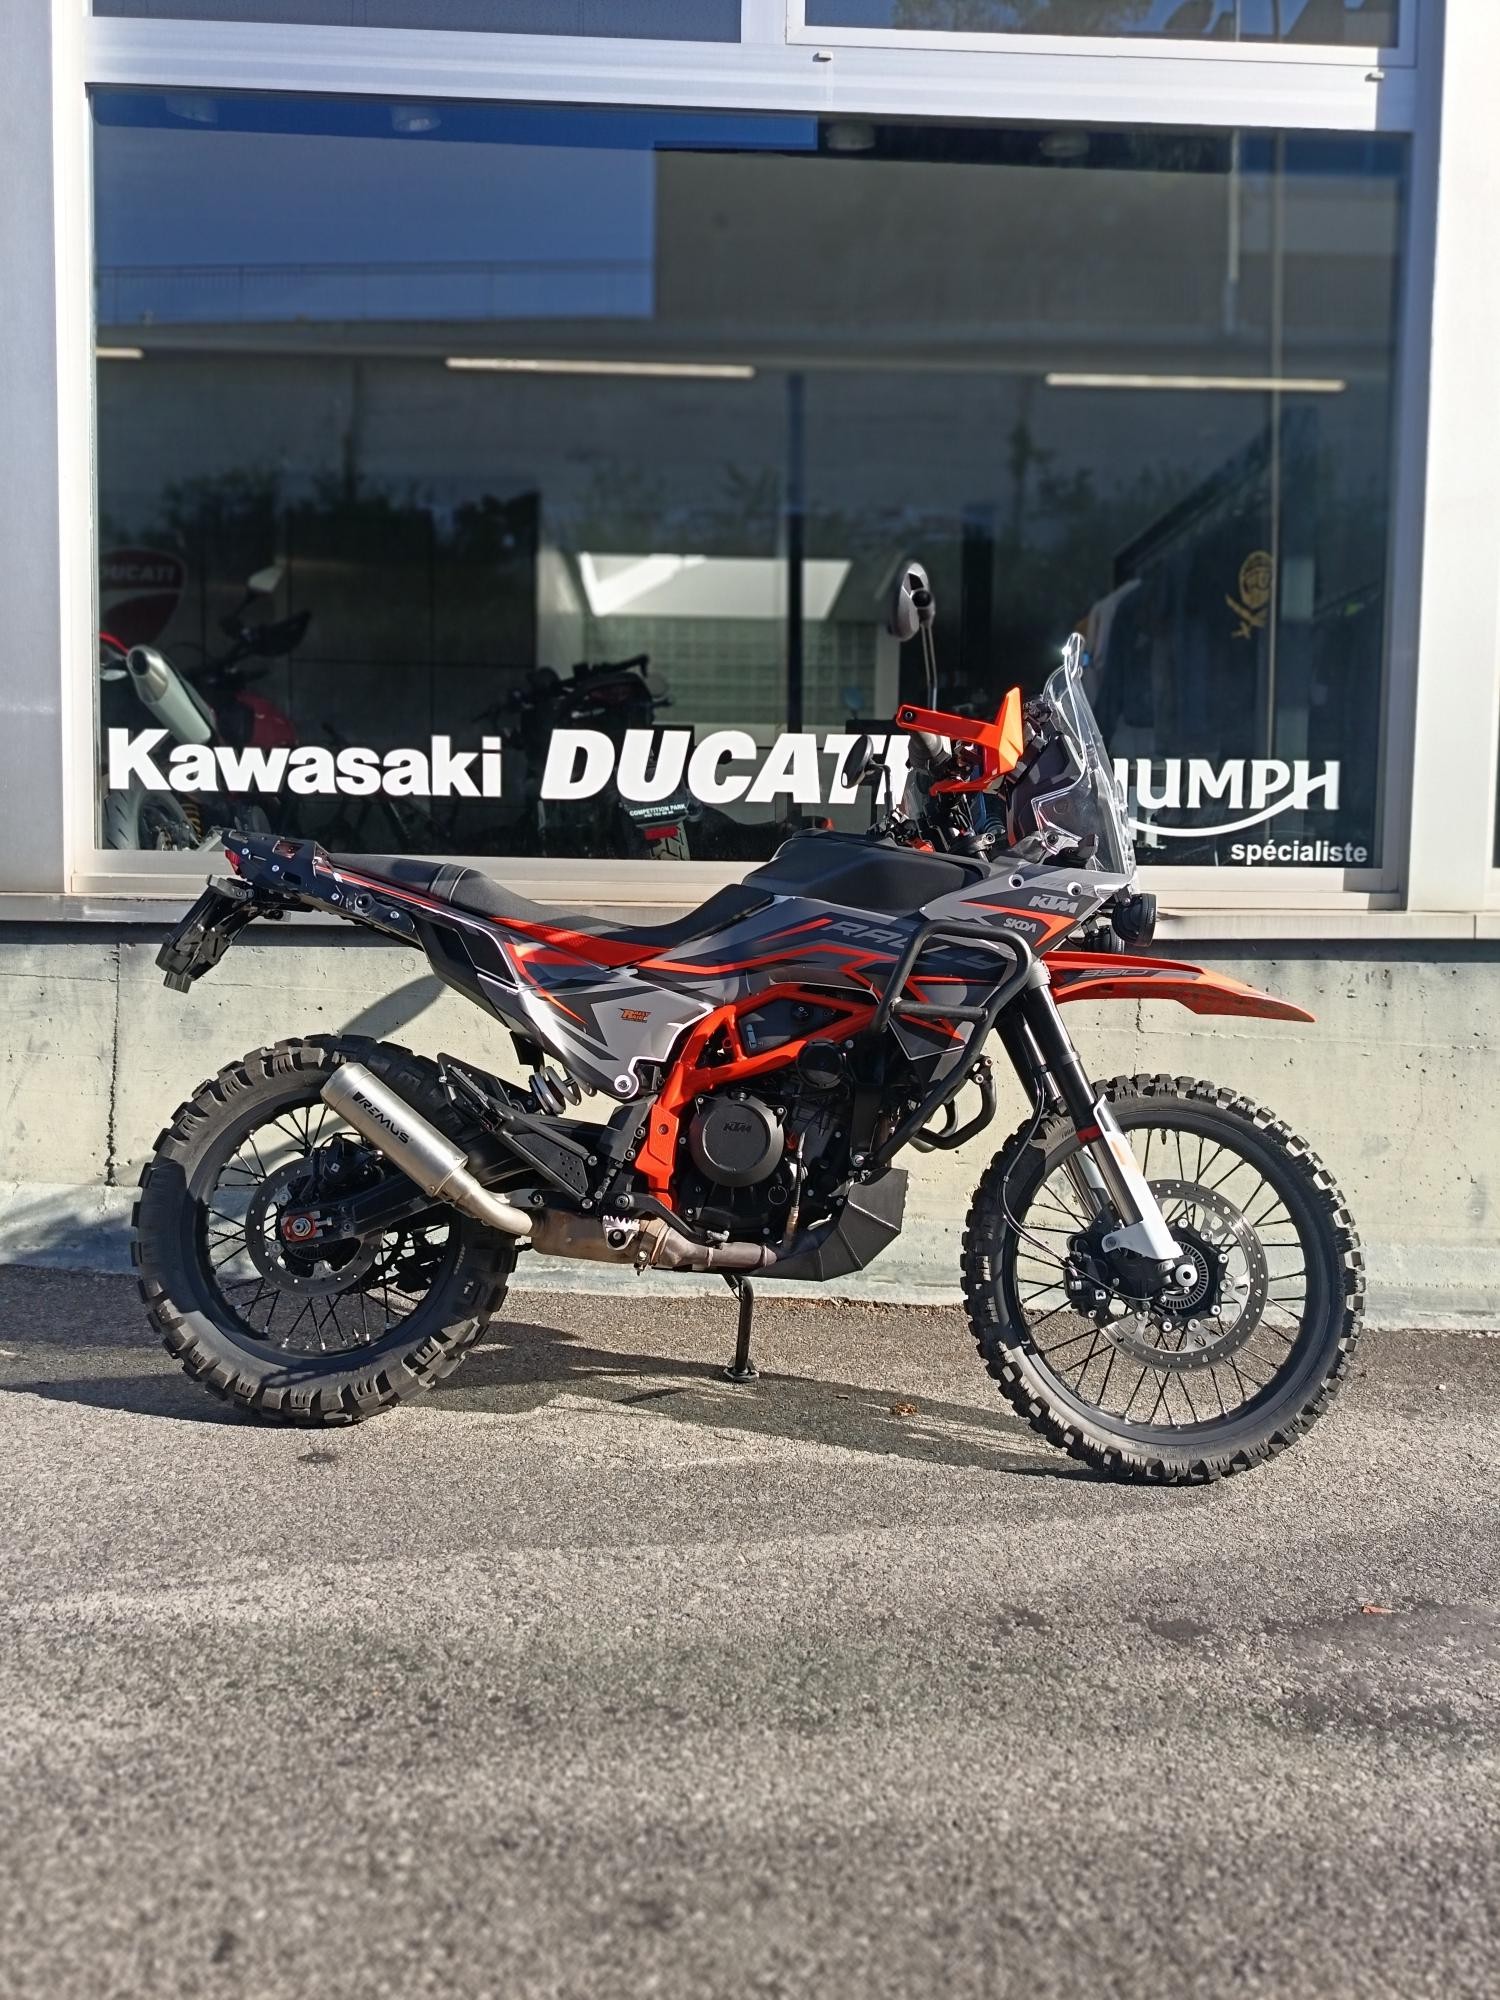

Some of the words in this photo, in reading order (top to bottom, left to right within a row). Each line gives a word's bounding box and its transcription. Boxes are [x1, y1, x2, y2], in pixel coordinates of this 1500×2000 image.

[107, 727, 502, 798] Kawasaki
[540, 728, 912, 805] DUCATI
[1112, 758, 1341, 812] IUMPH
[670, 803, 686, 811] PARK
[1230, 839, 1368, 866] spécialiste
[1028, 893, 1079, 914] KTM
[820, 920, 1006, 970] RALY
[358, 1098, 410, 1144] REMUS
[722, 1121, 753, 1133] KTM
